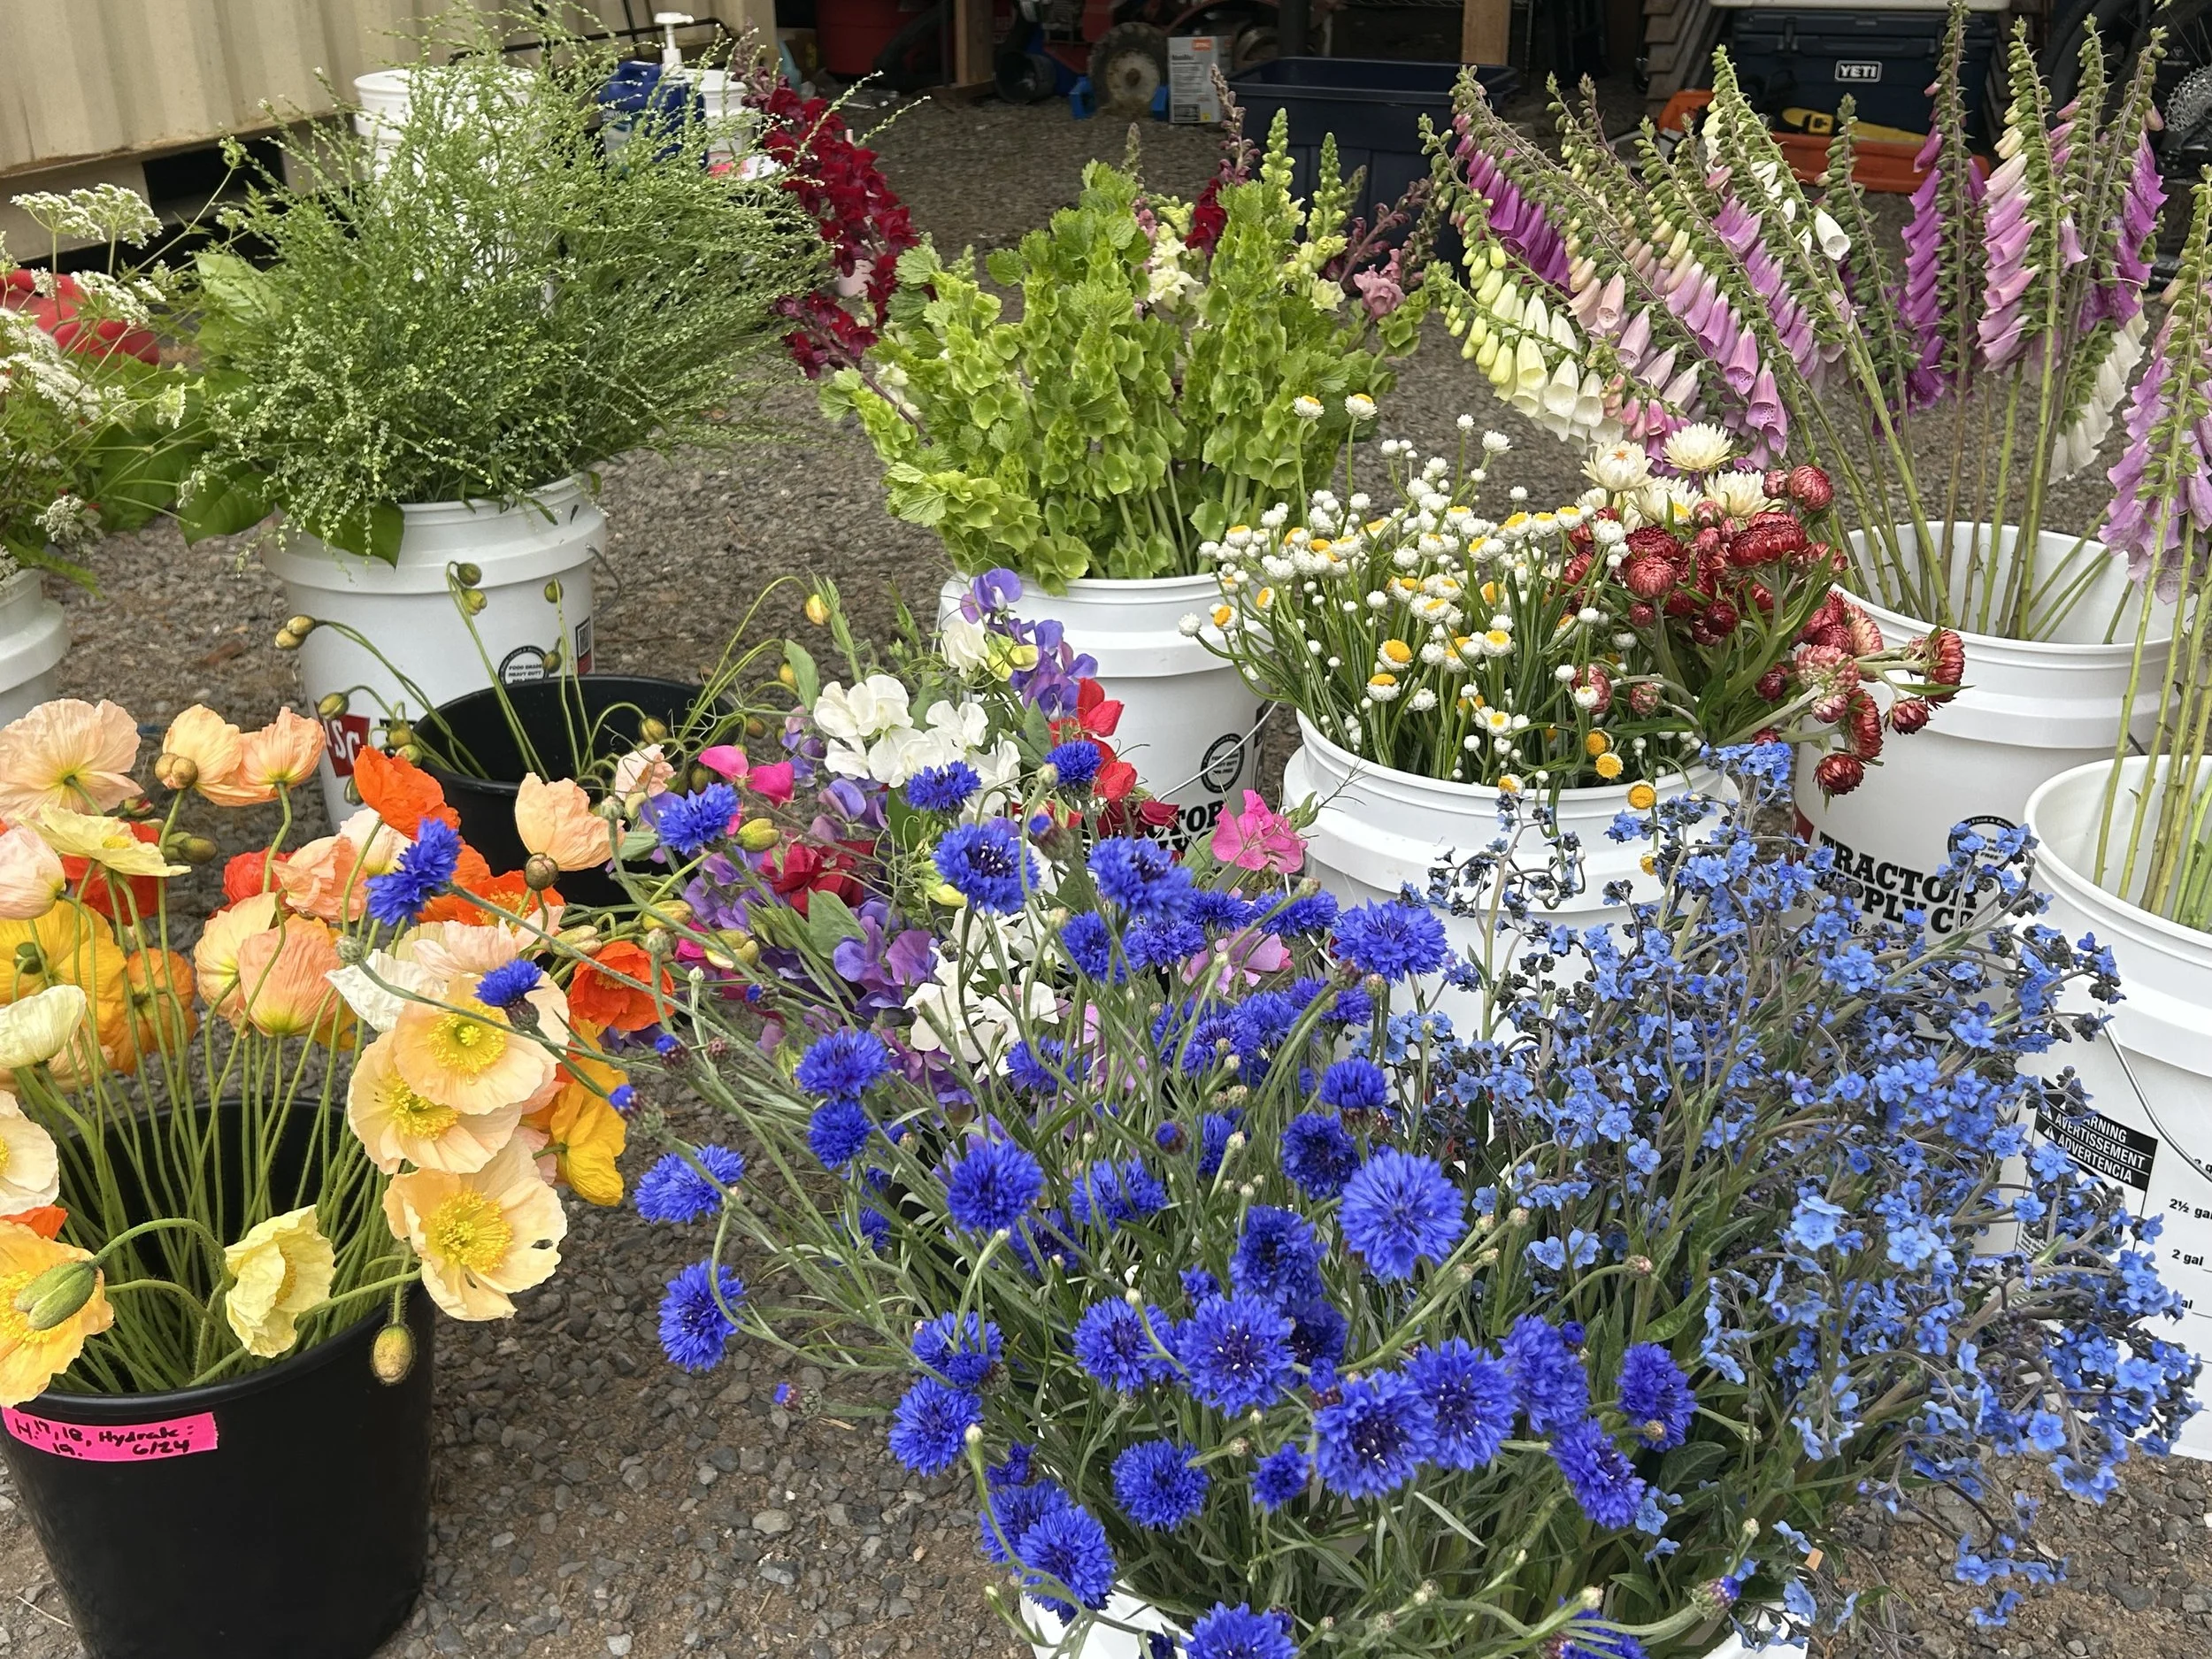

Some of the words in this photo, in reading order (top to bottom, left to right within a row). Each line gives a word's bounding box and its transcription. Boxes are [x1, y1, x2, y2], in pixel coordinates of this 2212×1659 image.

[1840, 65, 1877, 78] YETI
[2055, 1113, 2146, 1169] AVERTISSEMENT
[2057, 1134, 2132, 1184] ADVERTENCIA
[2171, 1248, 2181, 1259] 2
[2183, 1252, 2204, 1266] gal
[2180, 1299, 2193, 1310] al
